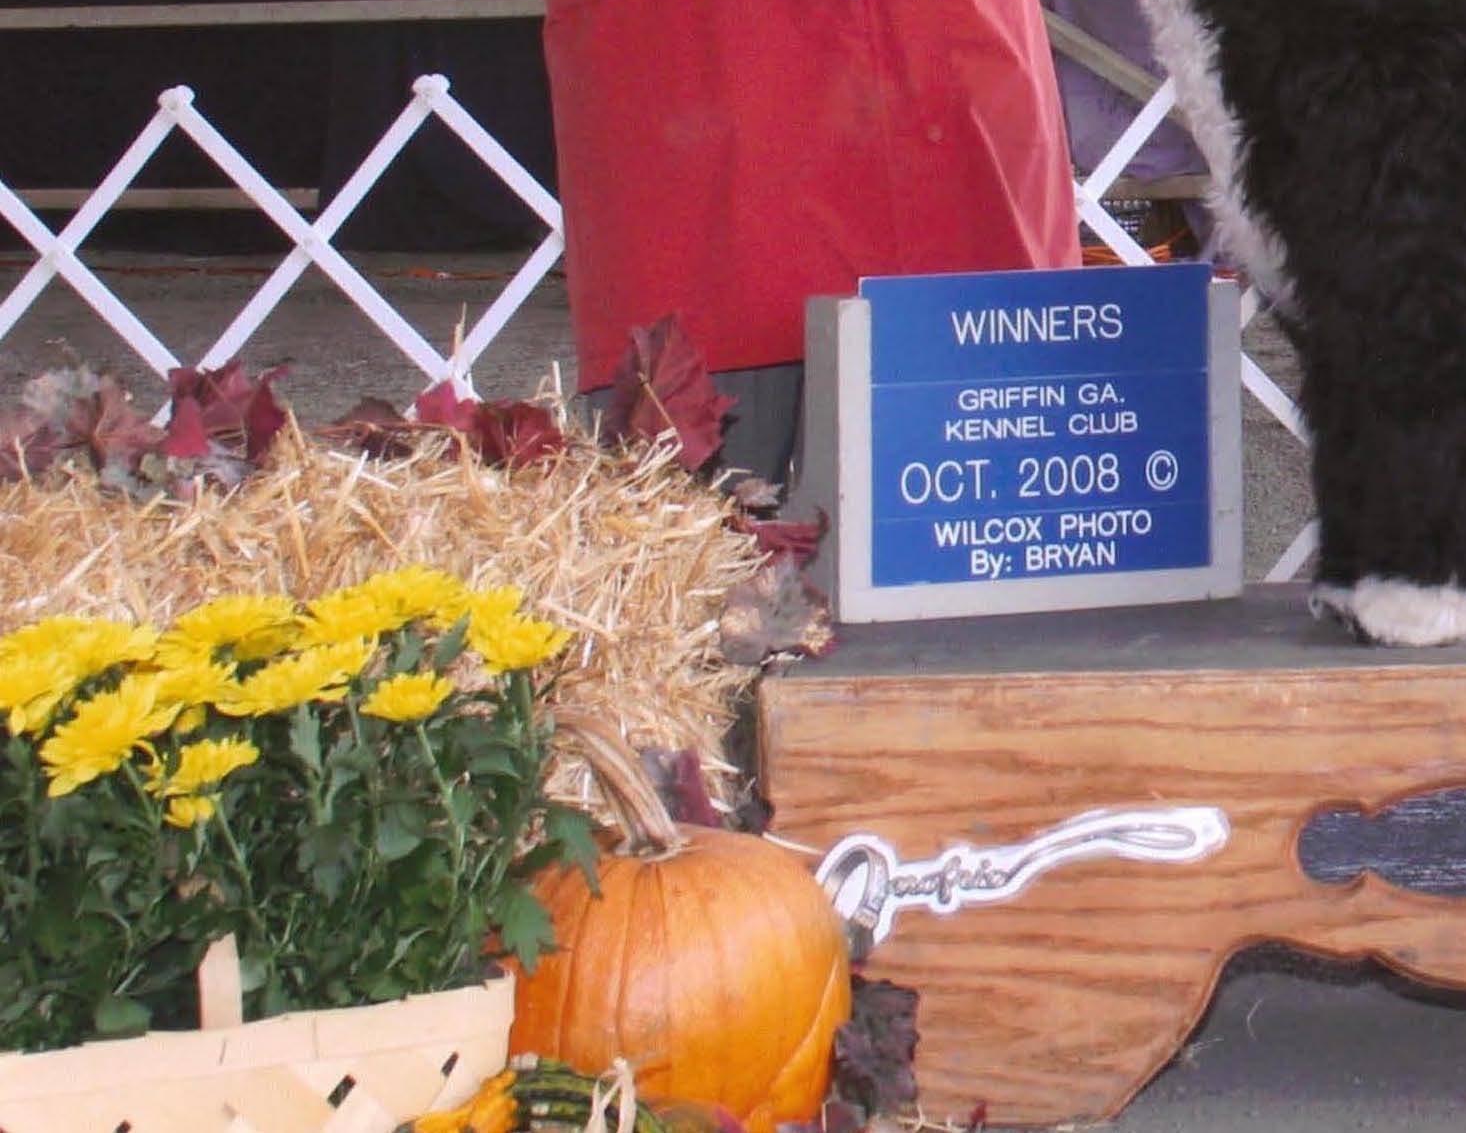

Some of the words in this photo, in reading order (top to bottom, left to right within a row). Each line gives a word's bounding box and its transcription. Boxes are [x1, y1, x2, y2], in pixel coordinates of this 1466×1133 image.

[952, 304, 1123, 345] WINNERS
[958, 385, 1065, 411] GRIFFIN
[1078, 383, 1125, 405] GA.
[945, 417, 1055, 441] KENNEL
[1068, 411, 1139, 434] CLUB
[901, 459, 998, 504] OCT.
[1018, 453, 1120, 498] 2008
[934, 516, 1042, 546] WILCOX
[1059, 509, 1152, 538] PHOTO
[970, 549, 1012, 578] By:
[1025, 542, 1116, 569] BRYAN
